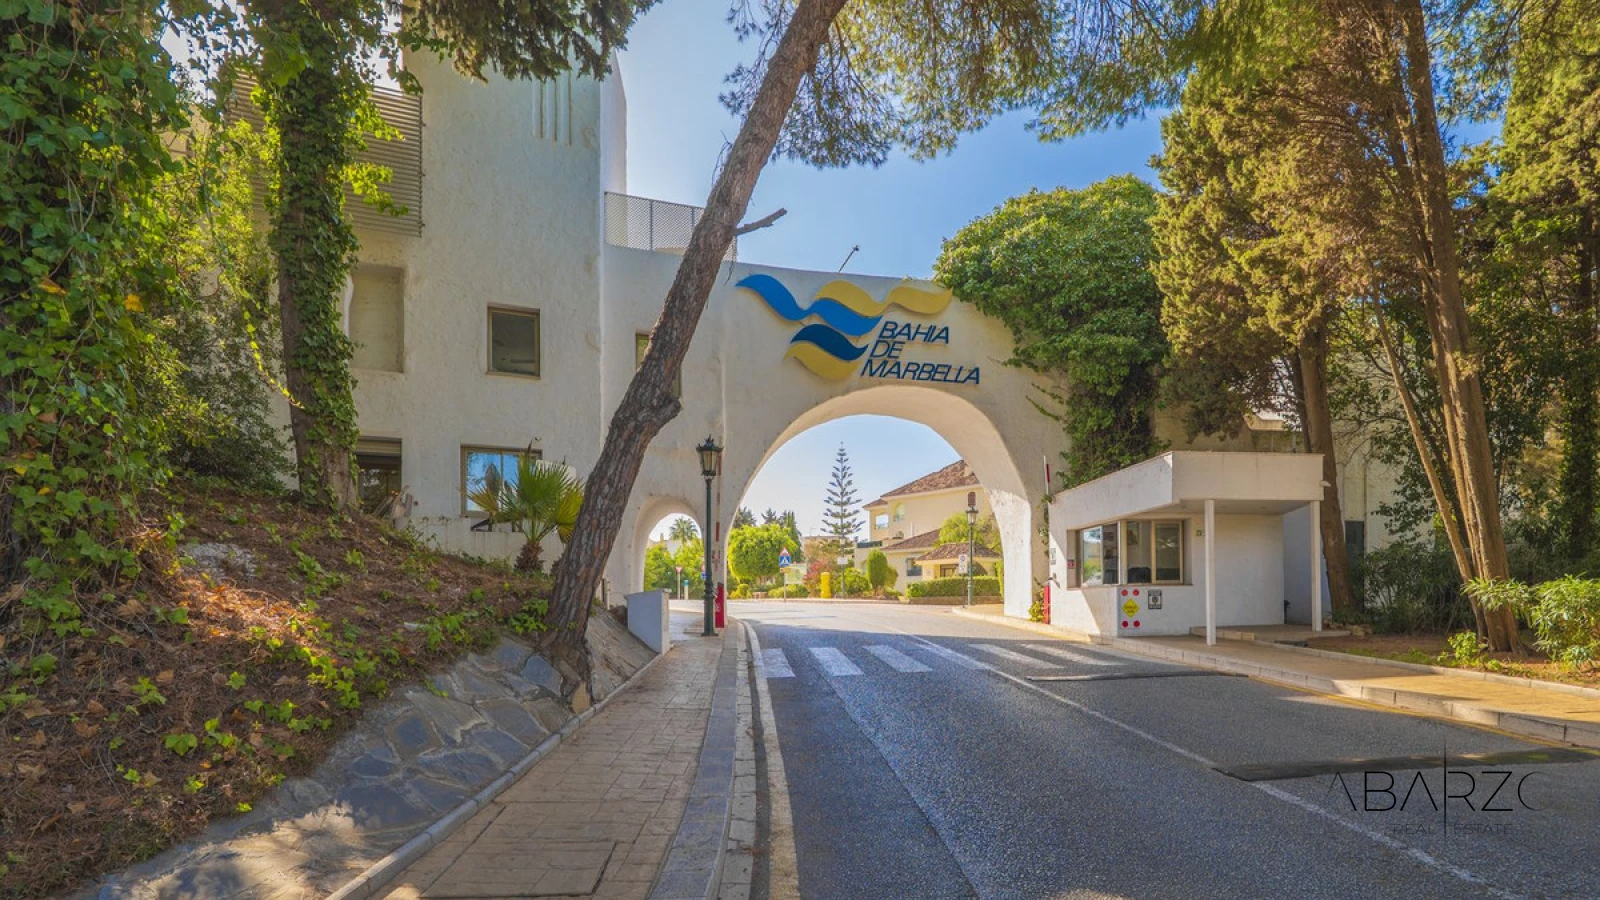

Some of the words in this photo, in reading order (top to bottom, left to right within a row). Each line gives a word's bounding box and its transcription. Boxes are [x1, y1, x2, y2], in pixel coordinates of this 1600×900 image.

[879, 321, 949, 344] BAHIA
[869, 340, 905, 358] DE
[861, 359, 980, 384] MARBELLA
